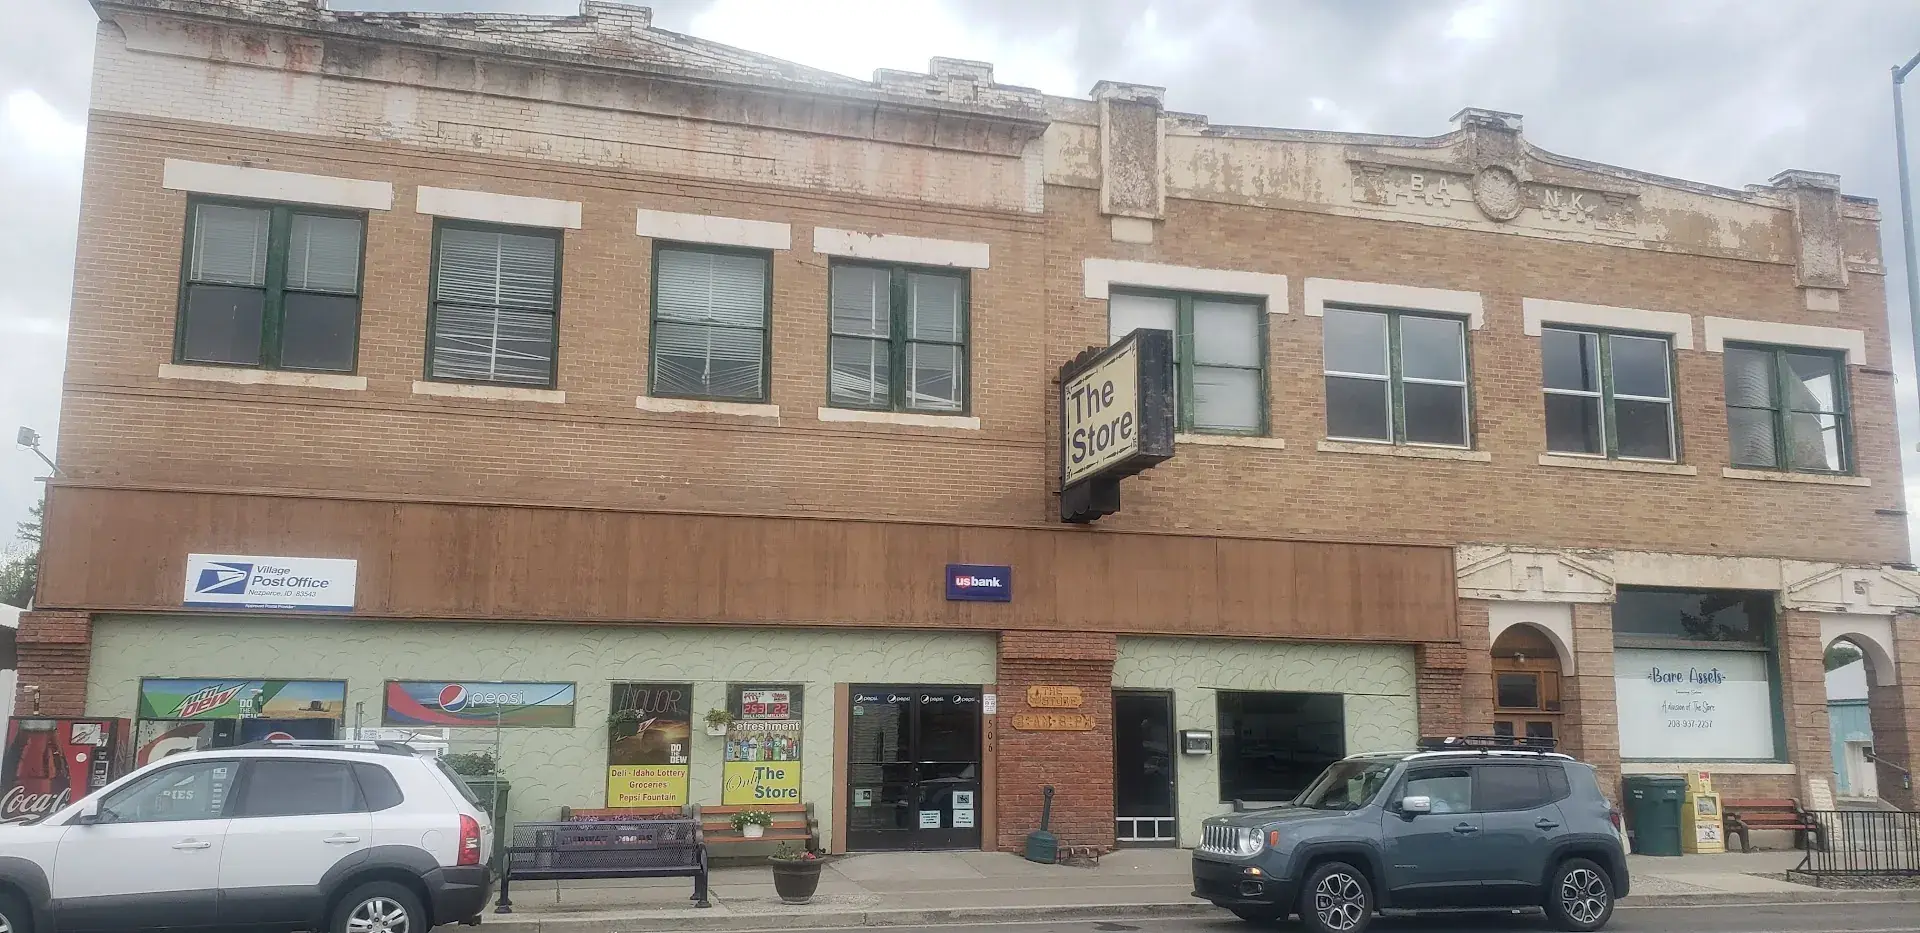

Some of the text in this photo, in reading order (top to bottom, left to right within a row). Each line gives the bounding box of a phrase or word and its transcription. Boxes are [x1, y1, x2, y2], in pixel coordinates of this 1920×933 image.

[1071, 380, 1114, 424] The
[1071, 411, 1133, 464] Store
[257, 565, 290, 575] Village
[251, 576, 329, 588] Post Office
[1652, 667, 1722, 684] Bare Assets
[1041, 687, 1062, 696] THE
[239, 699, 253, 708] DO
[471, 690, 525, 707] pepsi
[619, 689, 682, 713] LIQUOR
[744, 704, 788, 714] 253 22
[1661, 700, 1667, 713] A
[1693, 701, 1701, 712] The
[1702, 701, 1715, 713] Store
[670, 743, 681, 752] DO
[669, 755, 688, 764] DEW
[611, 769, 627, 777] Deli
[633, 769, 655, 777] Idaho
[657, 769, 685, 778] Lottery
[755, 766, 785, 780] The
[629, 781, 668, 789] Groceries
[754, 785, 798, 799] Store
[619, 793, 676, 803] Pepsi Fountain
